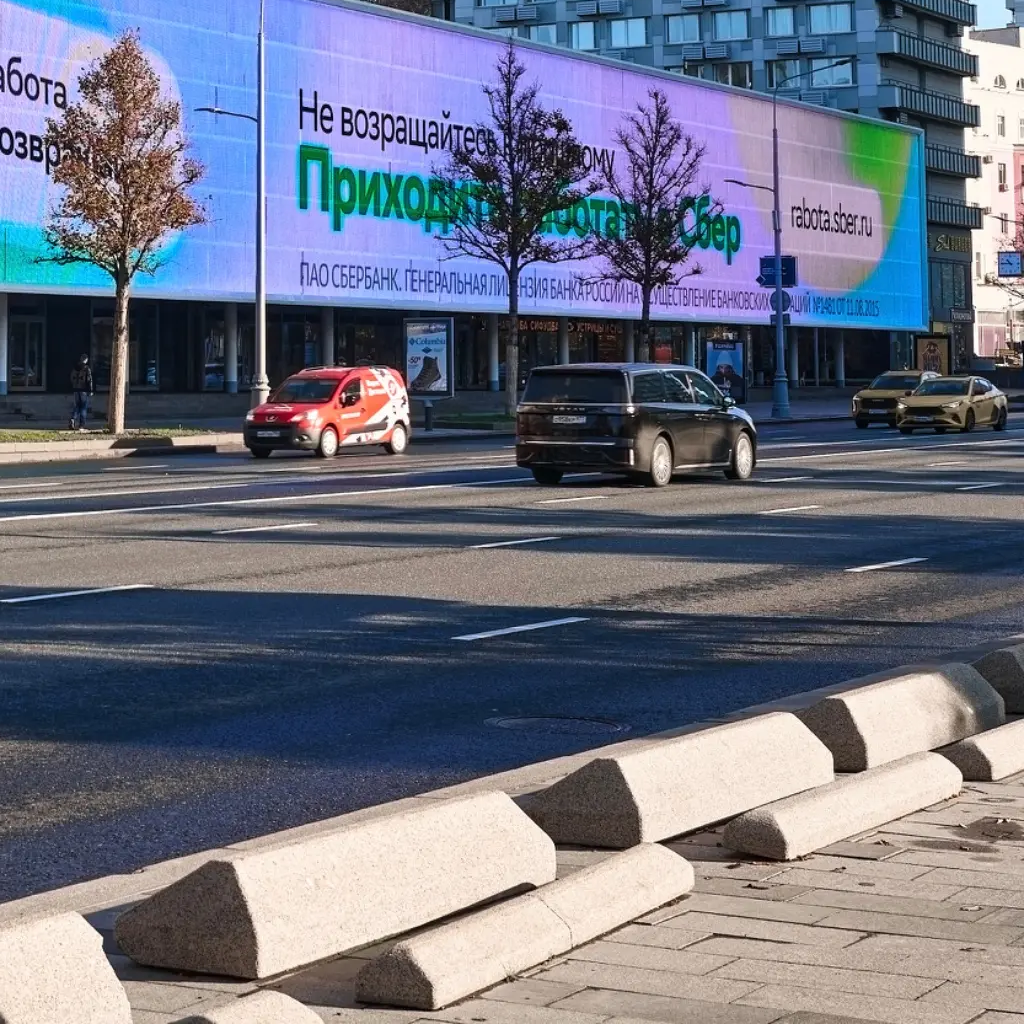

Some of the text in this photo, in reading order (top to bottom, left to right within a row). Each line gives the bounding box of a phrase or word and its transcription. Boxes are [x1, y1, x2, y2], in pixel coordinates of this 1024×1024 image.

[299, 88, 334, 134] Не
[679, 195, 741, 265] Сбер
[791, 196, 873, 238] rabota.sber.ru
[300, 261, 329, 288] ПАО
[331, 263, 402, 292] СБЕРБАНК.
[405, 268, 487, 296] ГЕНЕРАЛЬНАЯ
[488, 274, 547, 299] ЛИНЗИЯ
[550, 276, 584, 301] БАНКА
[585, 281, 626, 304] РОССИИ
[627, 283, 640, 304] НА
[643, 285, 716, 309] СУЩЕСТВЛЕНИЕ
[717, 289, 770, 312] БАНКОВСКИХ
[789, 291, 811, 316] АЦИЙ
